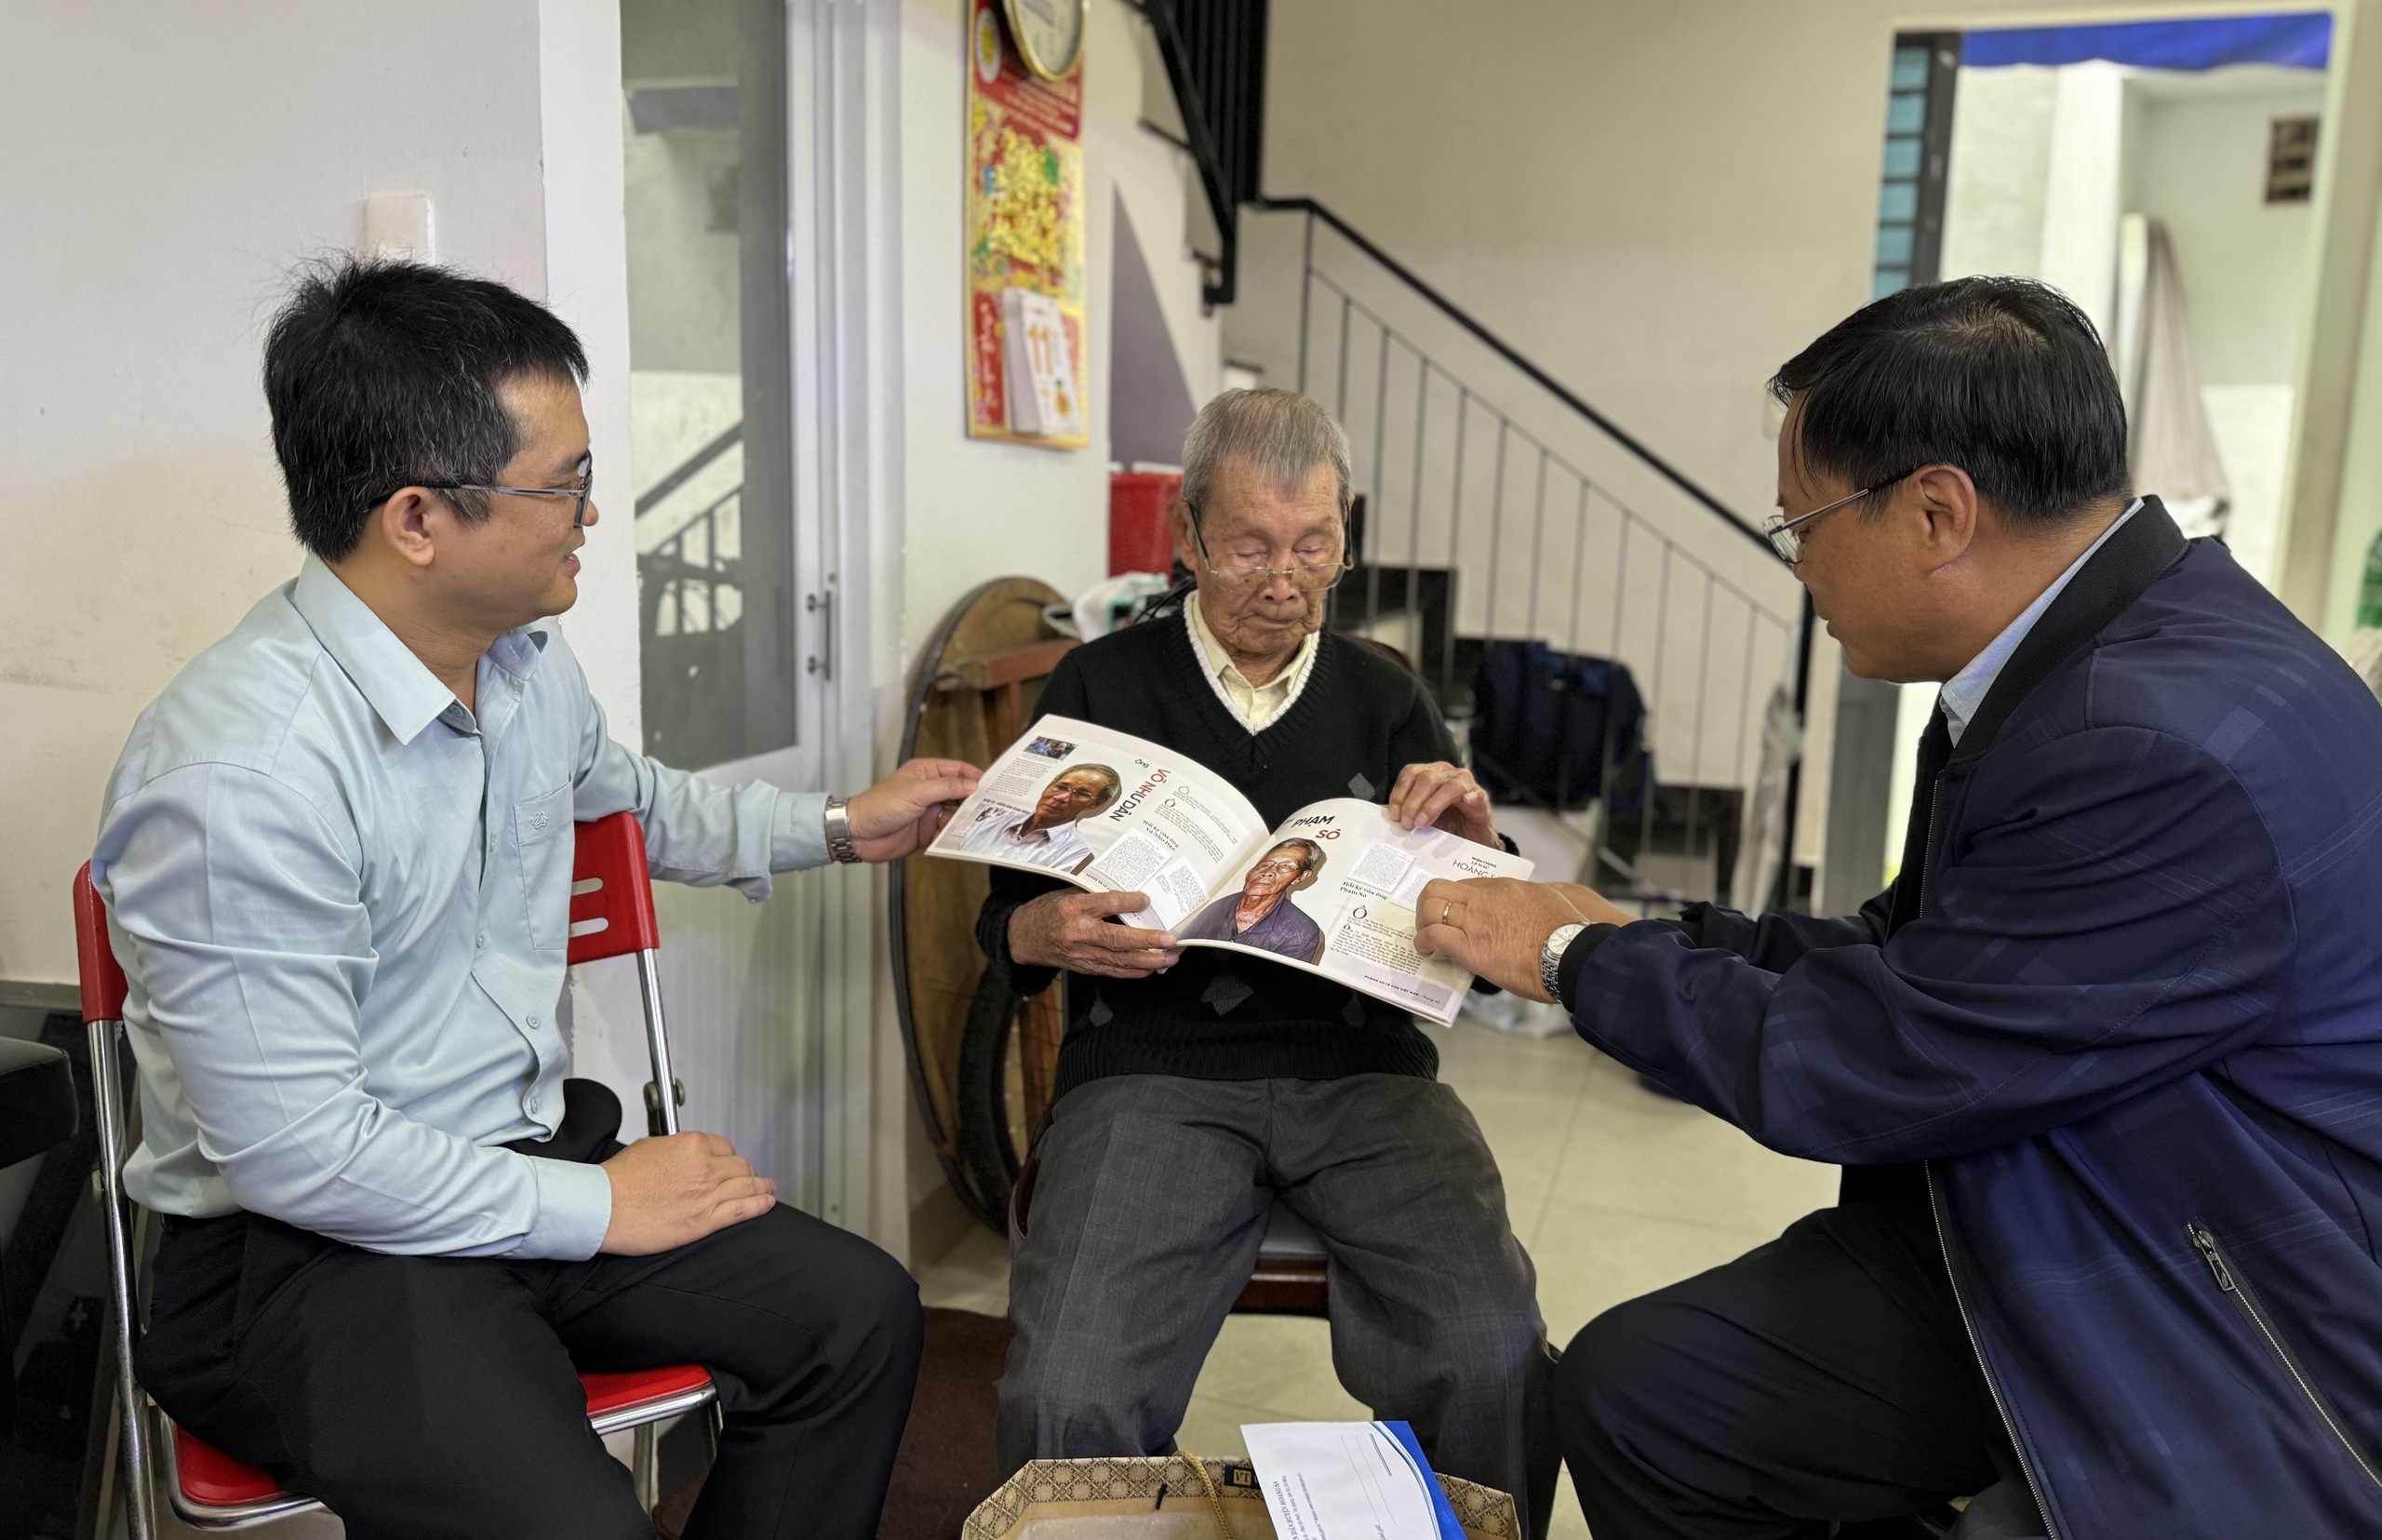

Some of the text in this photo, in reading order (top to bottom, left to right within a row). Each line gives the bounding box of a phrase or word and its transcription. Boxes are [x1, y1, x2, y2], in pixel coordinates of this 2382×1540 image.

[1108, 769, 1171, 823] VÕ NHƯ DÂN
[1291, 815, 1336, 828] PHẠM
[1315, 828, 1342, 840] SÔ
